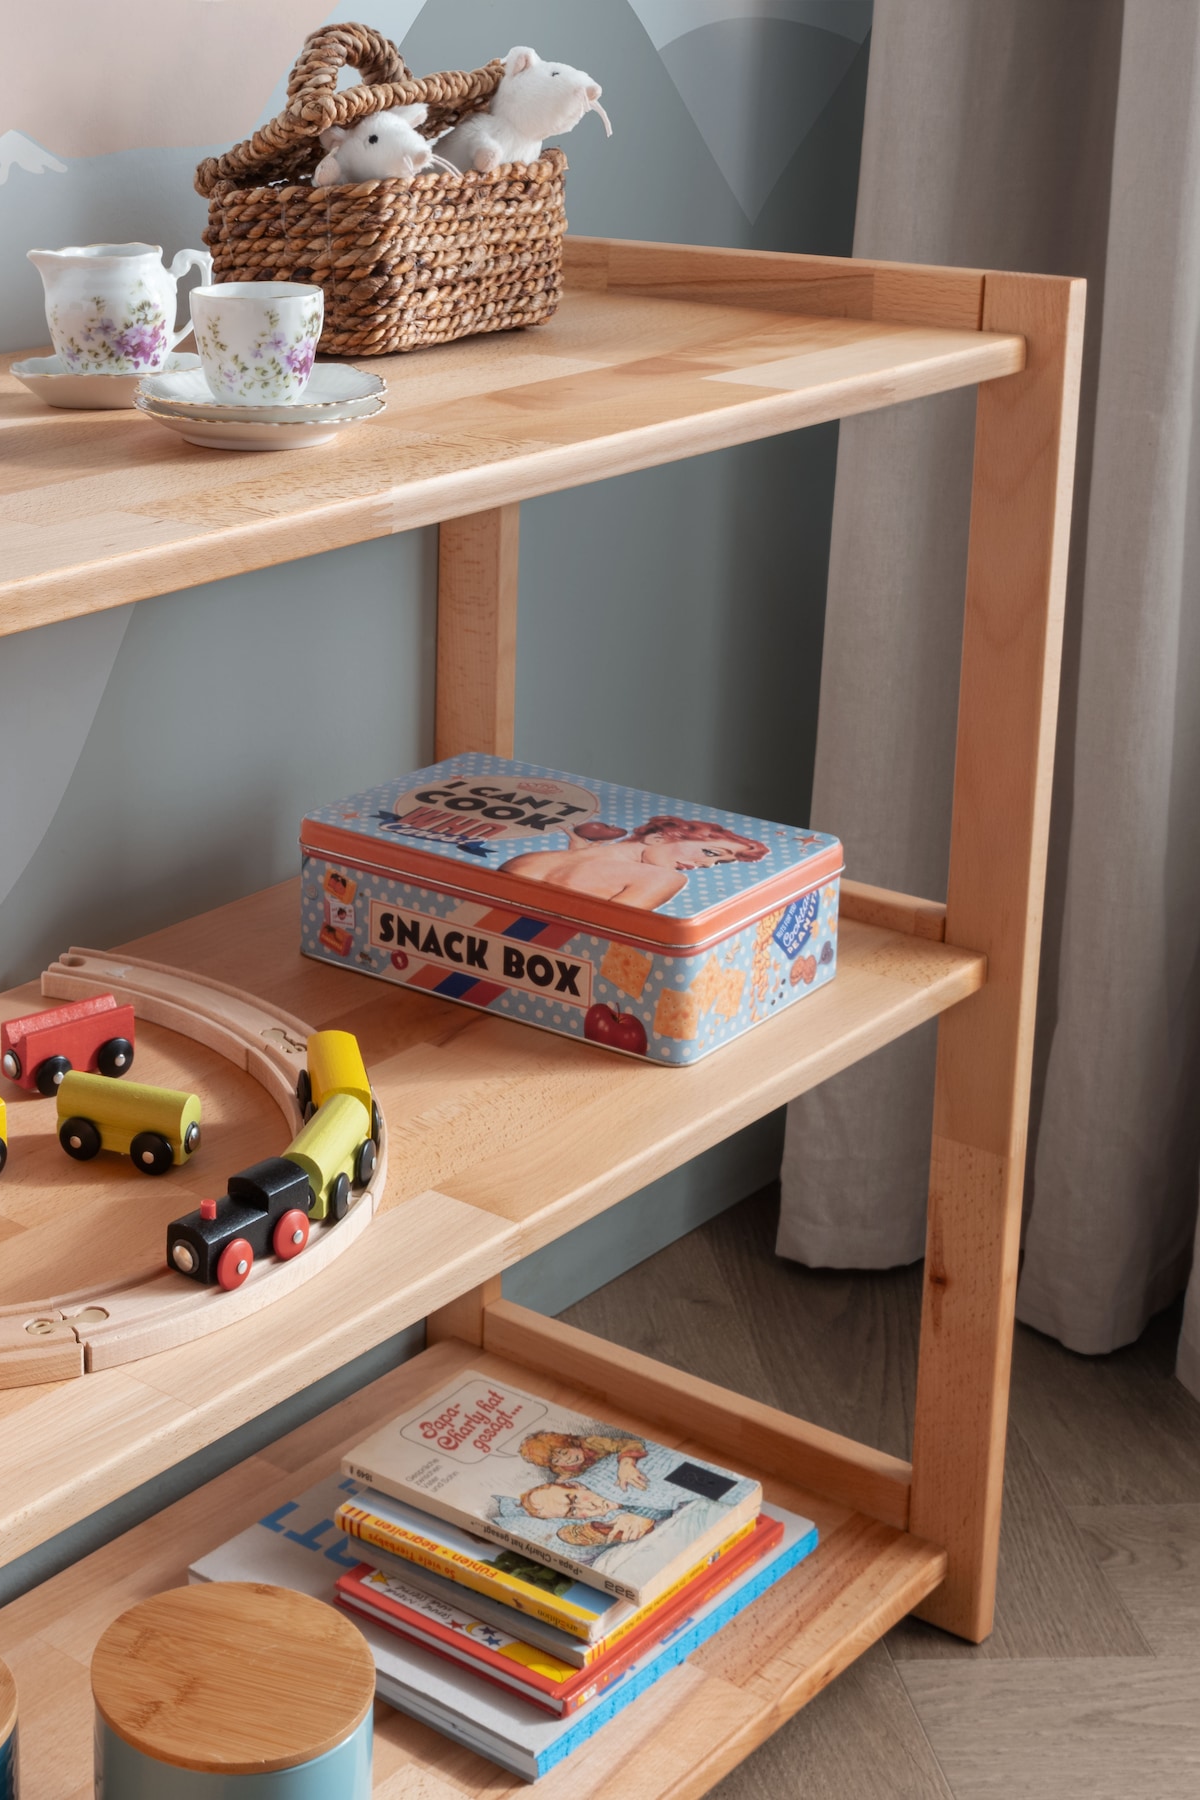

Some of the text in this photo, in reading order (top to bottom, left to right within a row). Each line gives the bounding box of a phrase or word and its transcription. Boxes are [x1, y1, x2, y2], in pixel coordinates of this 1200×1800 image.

[415, 790, 565, 831] COOK
[443, 781, 588, 817] I CAN'T
[400, 806, 508, 839] WHO
[379, 912, 582, 997] SNACK BOX
[437, 1389, 505, 1451] Charly hat
[373, 1518, 436, 1554] Begreifen
[510, 1538, 525, 1550] hat
[368, 1532, 456, 1579] So viele Tierbabys
[452, 1553, 499, 1579] Fühlen
